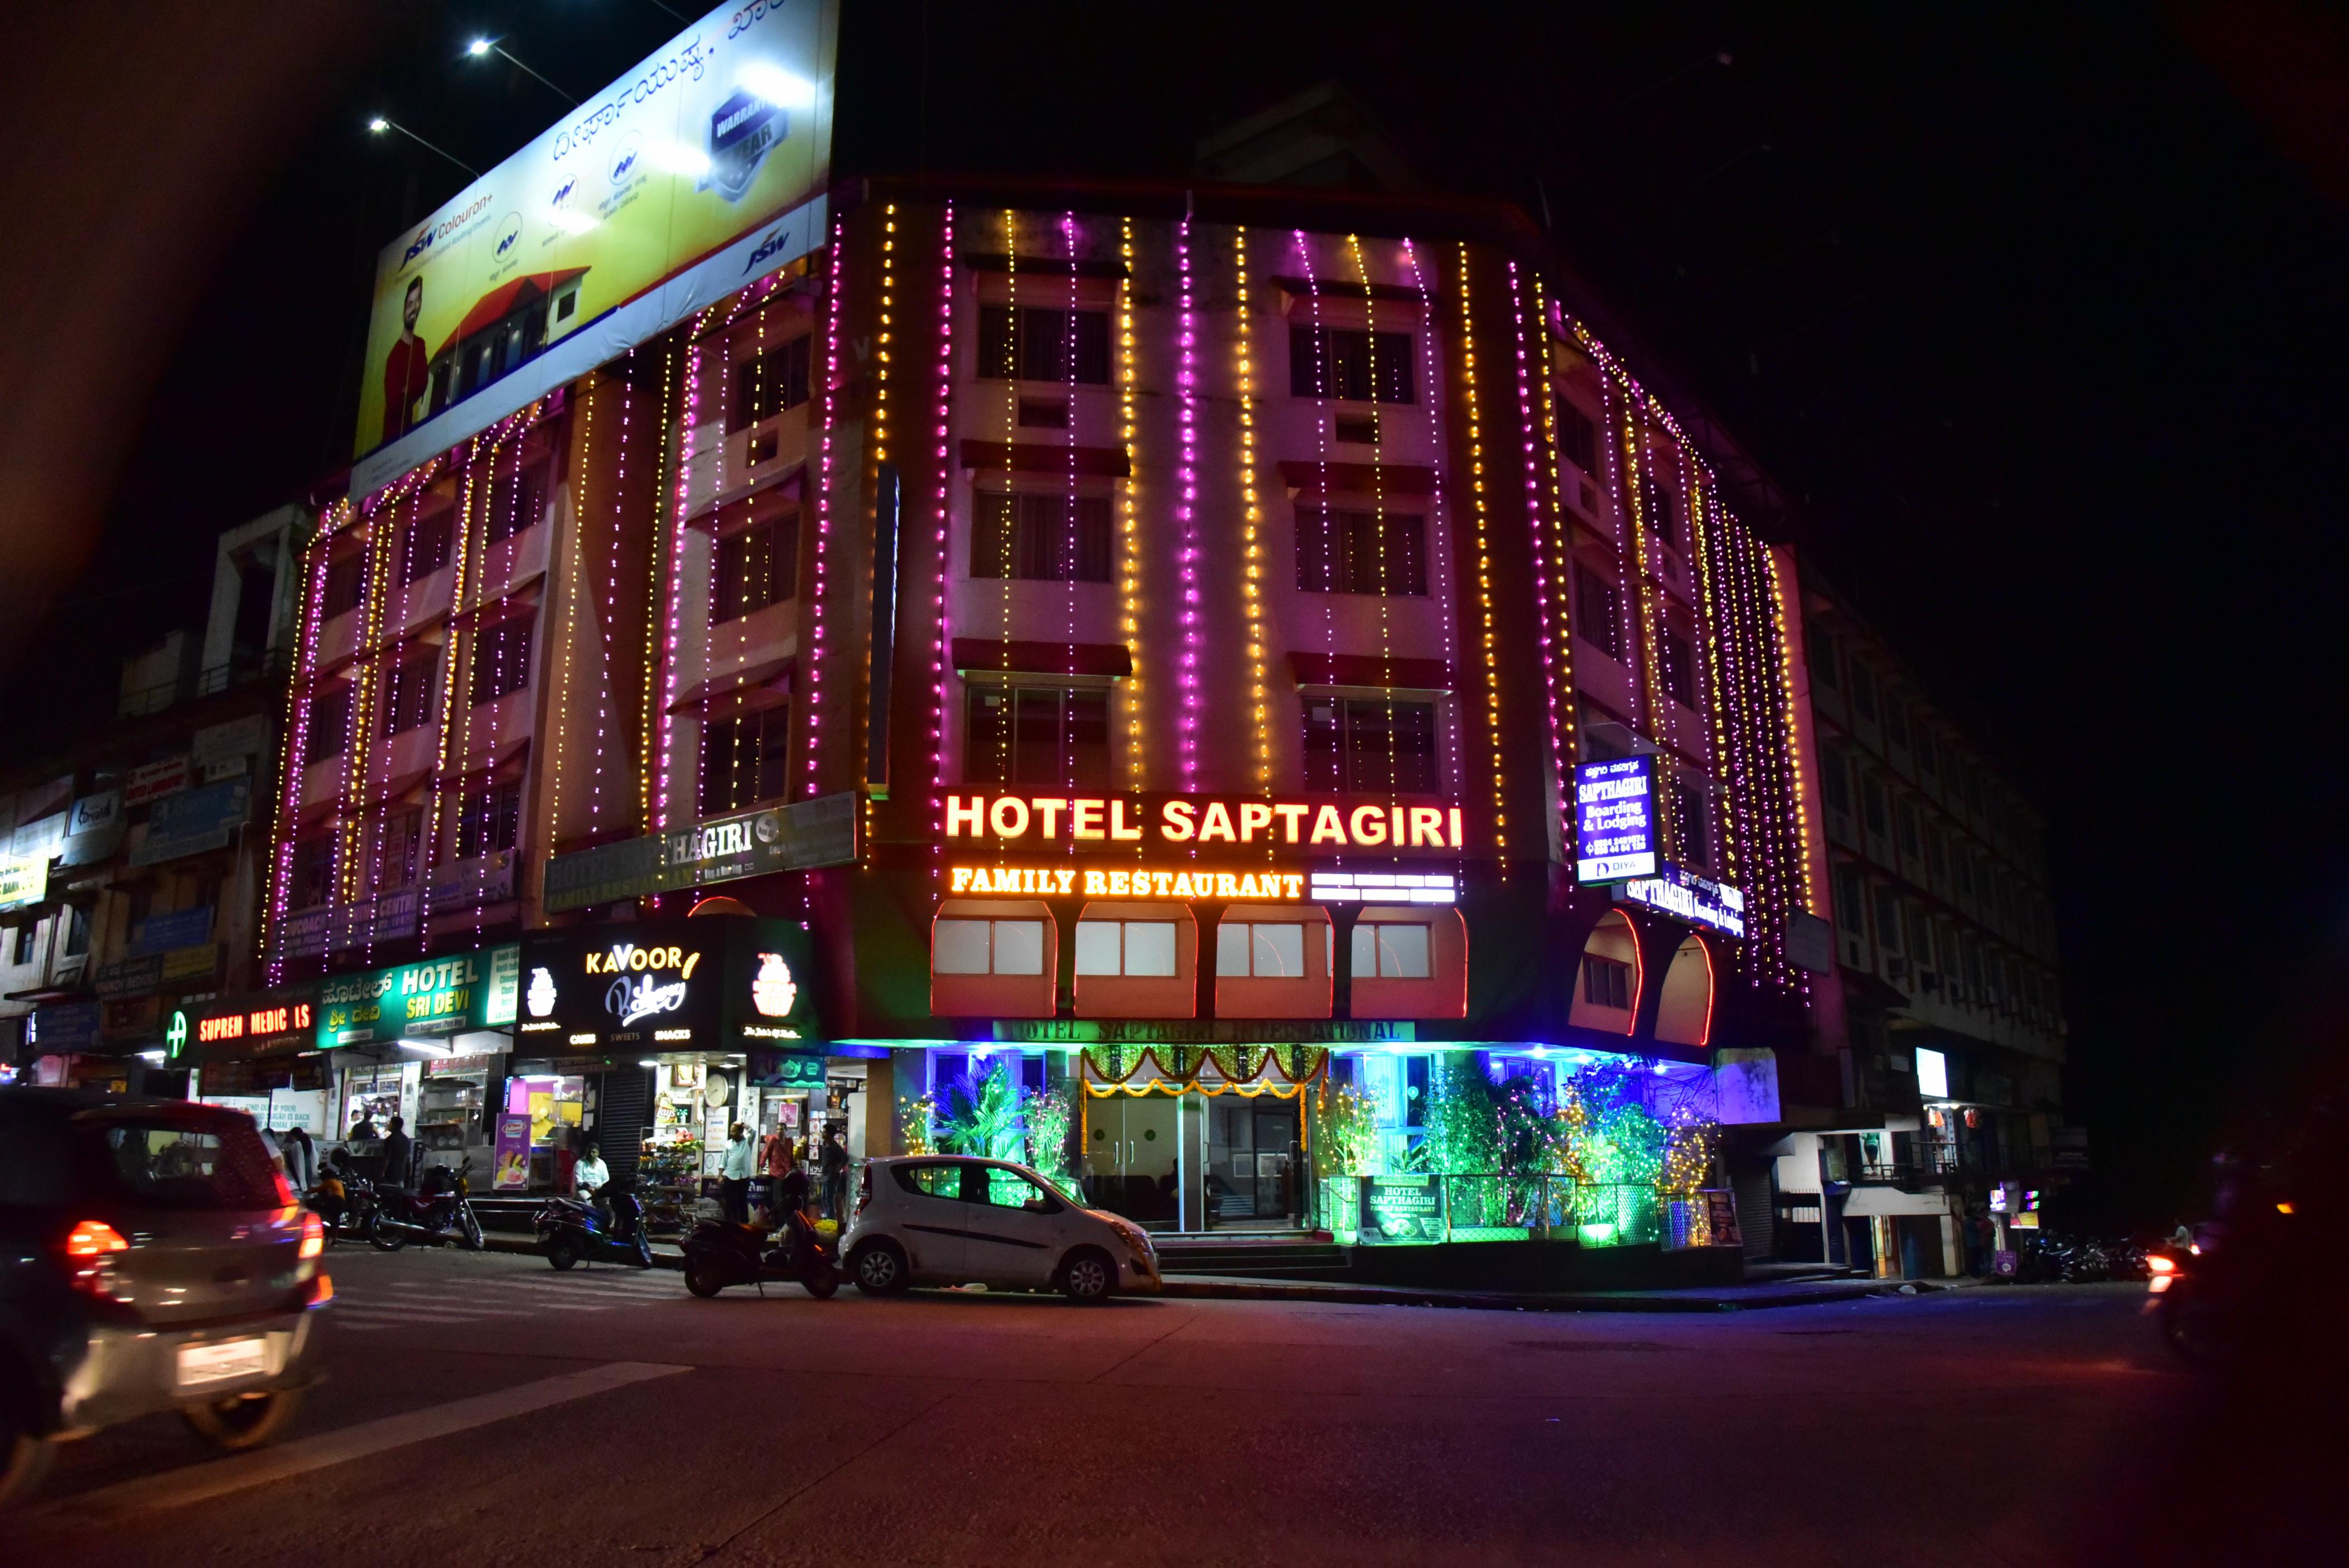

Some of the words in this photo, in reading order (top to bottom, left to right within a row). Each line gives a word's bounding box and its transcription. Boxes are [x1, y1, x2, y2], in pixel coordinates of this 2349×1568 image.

[399, 226, 437, 272] JSW
[742, 230, 790, 276] JSW
[946, 795, 1141, 840] HOTEL
[1161, 800, 1463, 847] SAPTAGIRI
[1583, 819, 1594, 831] &
[1597, 813, 1647, 829] Lodging
[1586, 800, 1642, 818] Boarding
[1613, 861, 1636, 871] DIYA
[952, 867, 1076, 895] FAMILY
[1085, 869, 1304, 899] RESTAURANT
[586, 943, 682, 974] KAVOOR
[402, 958, 479, 996] HOTEL
[406, 996, 431, 1020] SRI
[435, 990, 470, 1015] DEVI
[610, 1032, 641, 1042] SWEETS
[655, 1029, 691, 1041] SNACKS
[1369, 1195, 1436, 1205] SAPTHAGIRI
[1384, 1186, 1421, 1196] HOTEL
